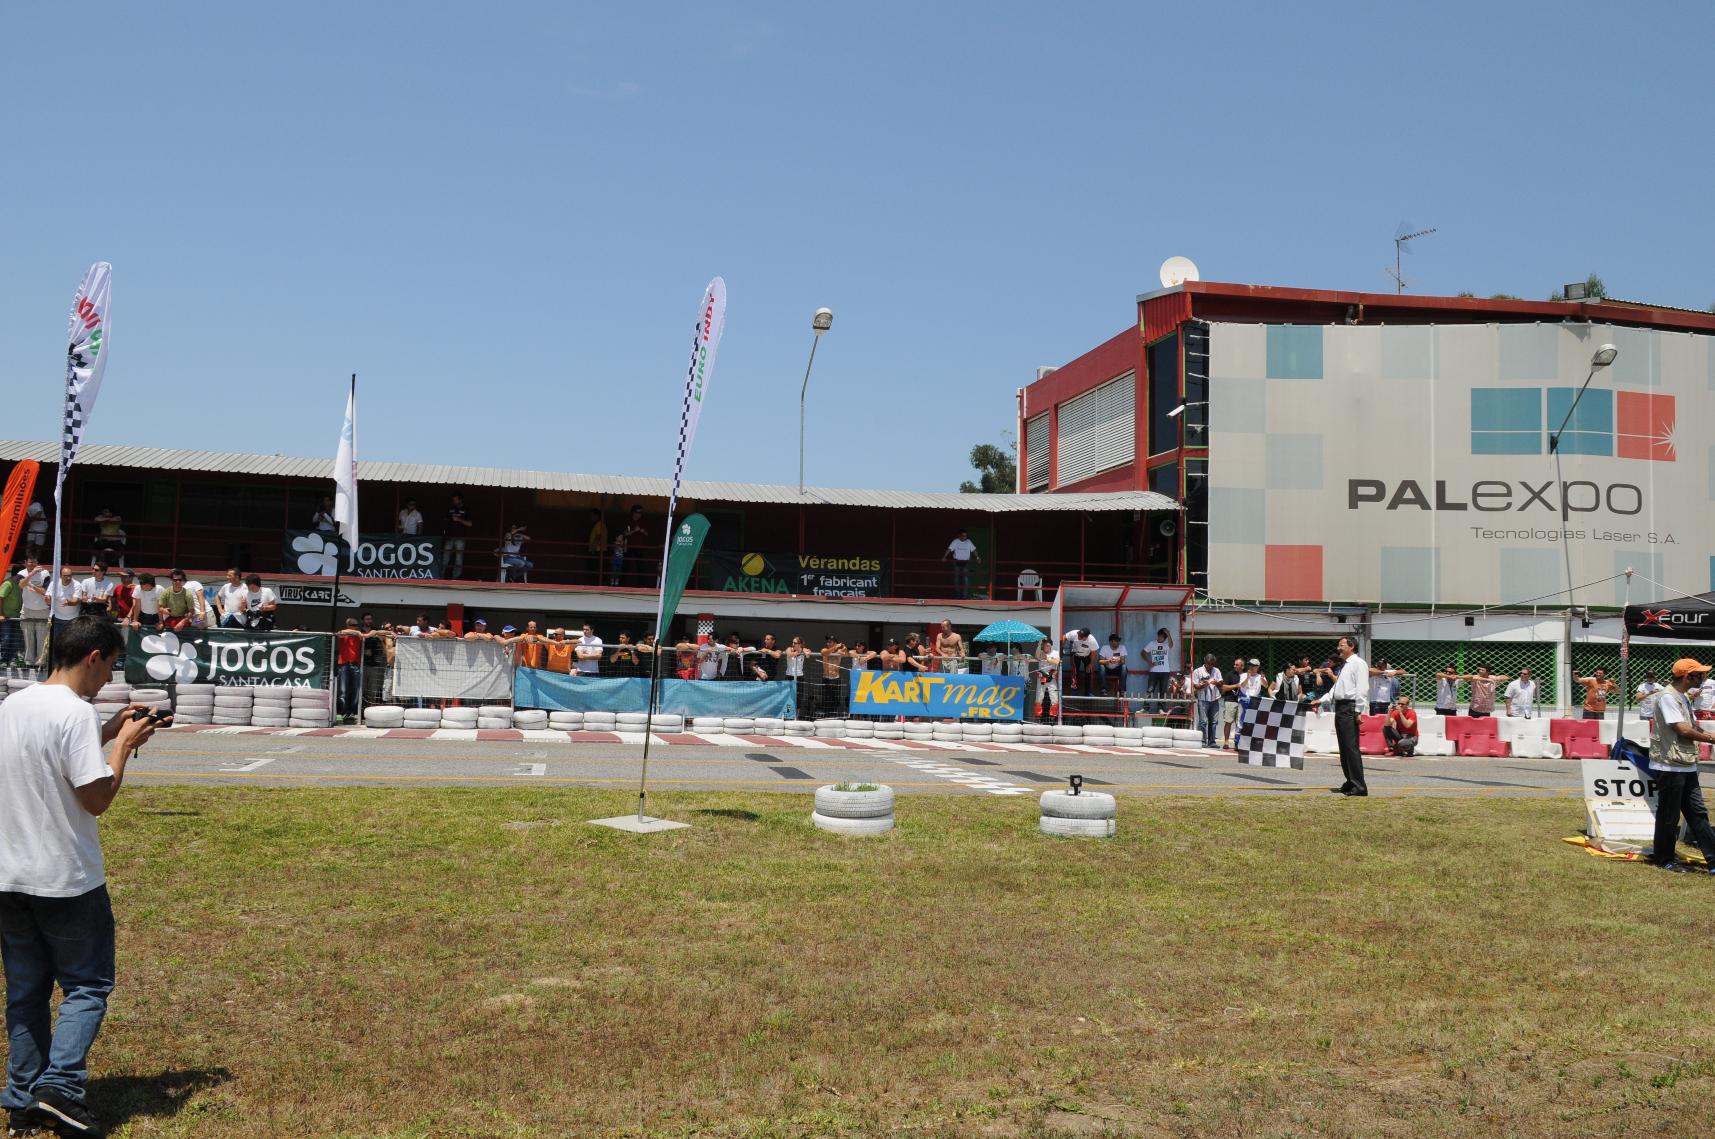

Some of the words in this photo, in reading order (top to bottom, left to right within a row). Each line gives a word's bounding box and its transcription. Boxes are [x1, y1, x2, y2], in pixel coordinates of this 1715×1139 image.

[694, 346, 706, 402] EURO
[1348, 478, 1642, 522] PALexpo
[1470, 526, 1586, 542] Tecnologias
[1593, 528, 1640, 543] Laser
[1648, 532, 1680, 545] S.A.
[347, 543, 434, 573] JOGOS
[799, 555, 881, 571] Vérandas
[358, 567, 434, 579] SANTACASA
[800, 574, 815, 586] 1er
[820, 575, 879, 588] fabricant
[280, 586, 303, 601] VIRUS
[722, 575, 790, 594] AKENA
[206, 643, 316, 680] JOGOS
[219, 675, 312, 688] SANTACASA
[854, 671, 945, 704] KART
[942, 684, 1021, 717] mag
[1594, 778, 1660, 798] STOP
